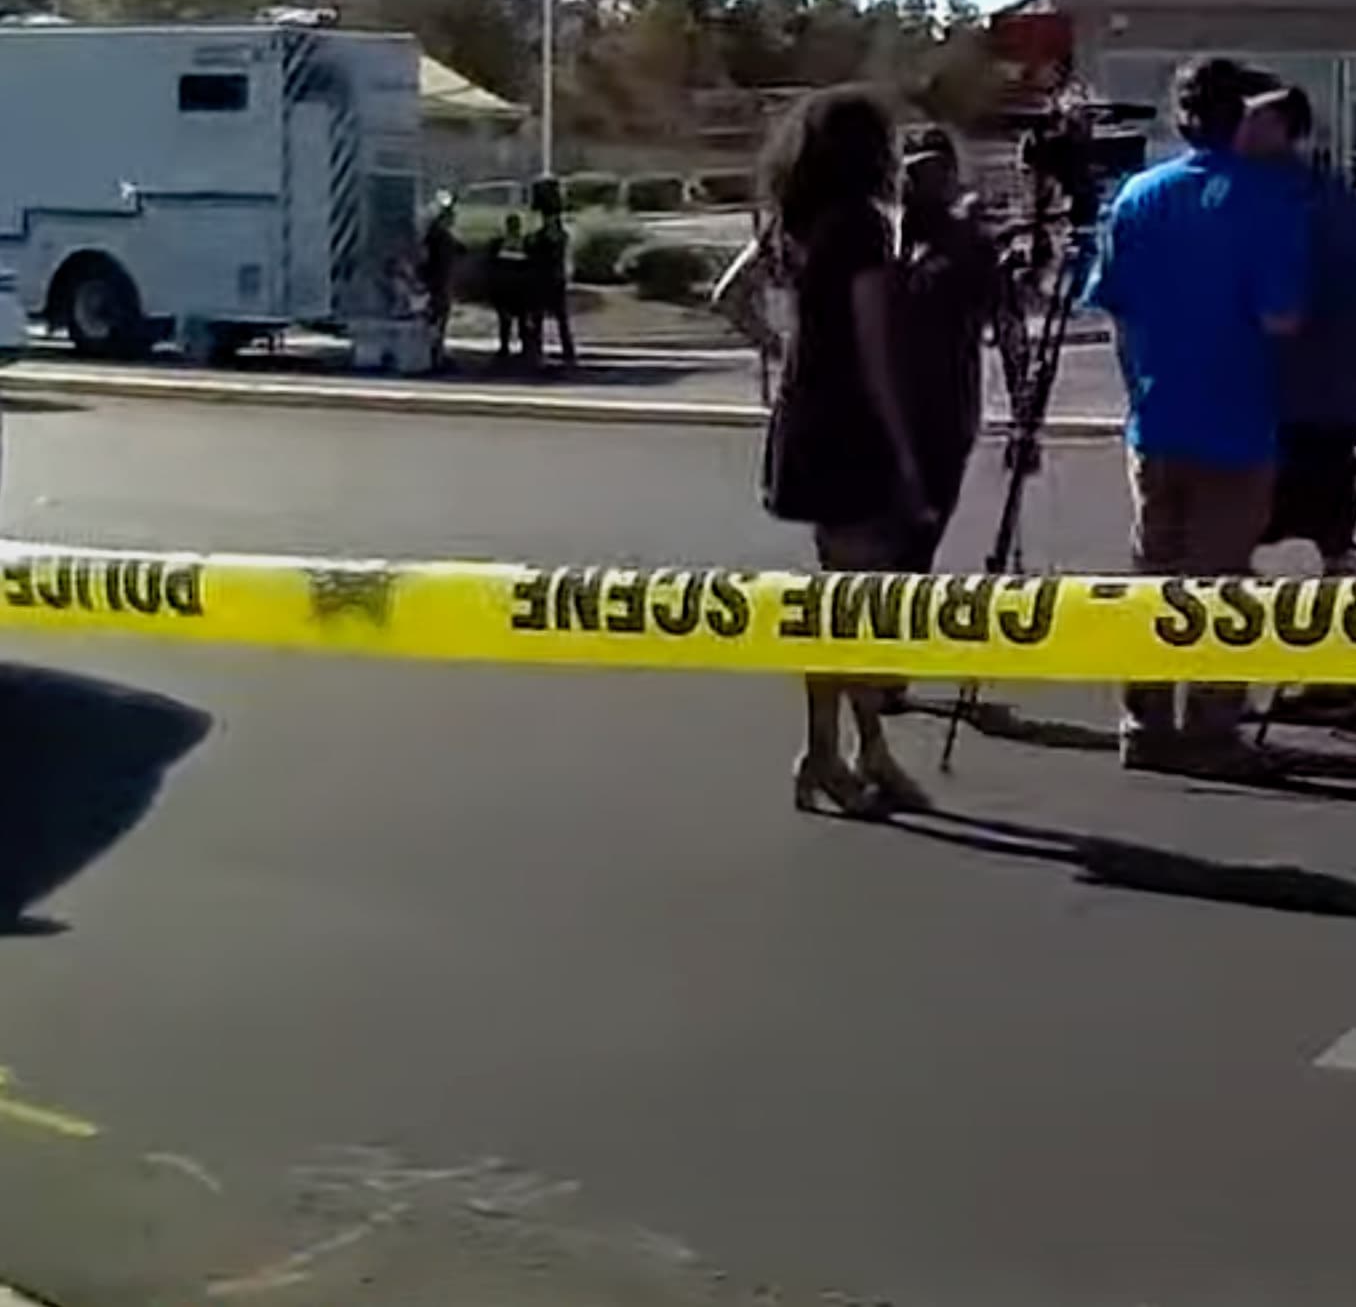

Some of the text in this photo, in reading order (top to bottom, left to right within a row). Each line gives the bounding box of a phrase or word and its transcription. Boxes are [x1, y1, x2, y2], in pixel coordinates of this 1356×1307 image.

[2, 556, 204, 617] POLICE
[511, 567, 750, 638] SCENE
[779, 574, 1061, 644] CRIME
